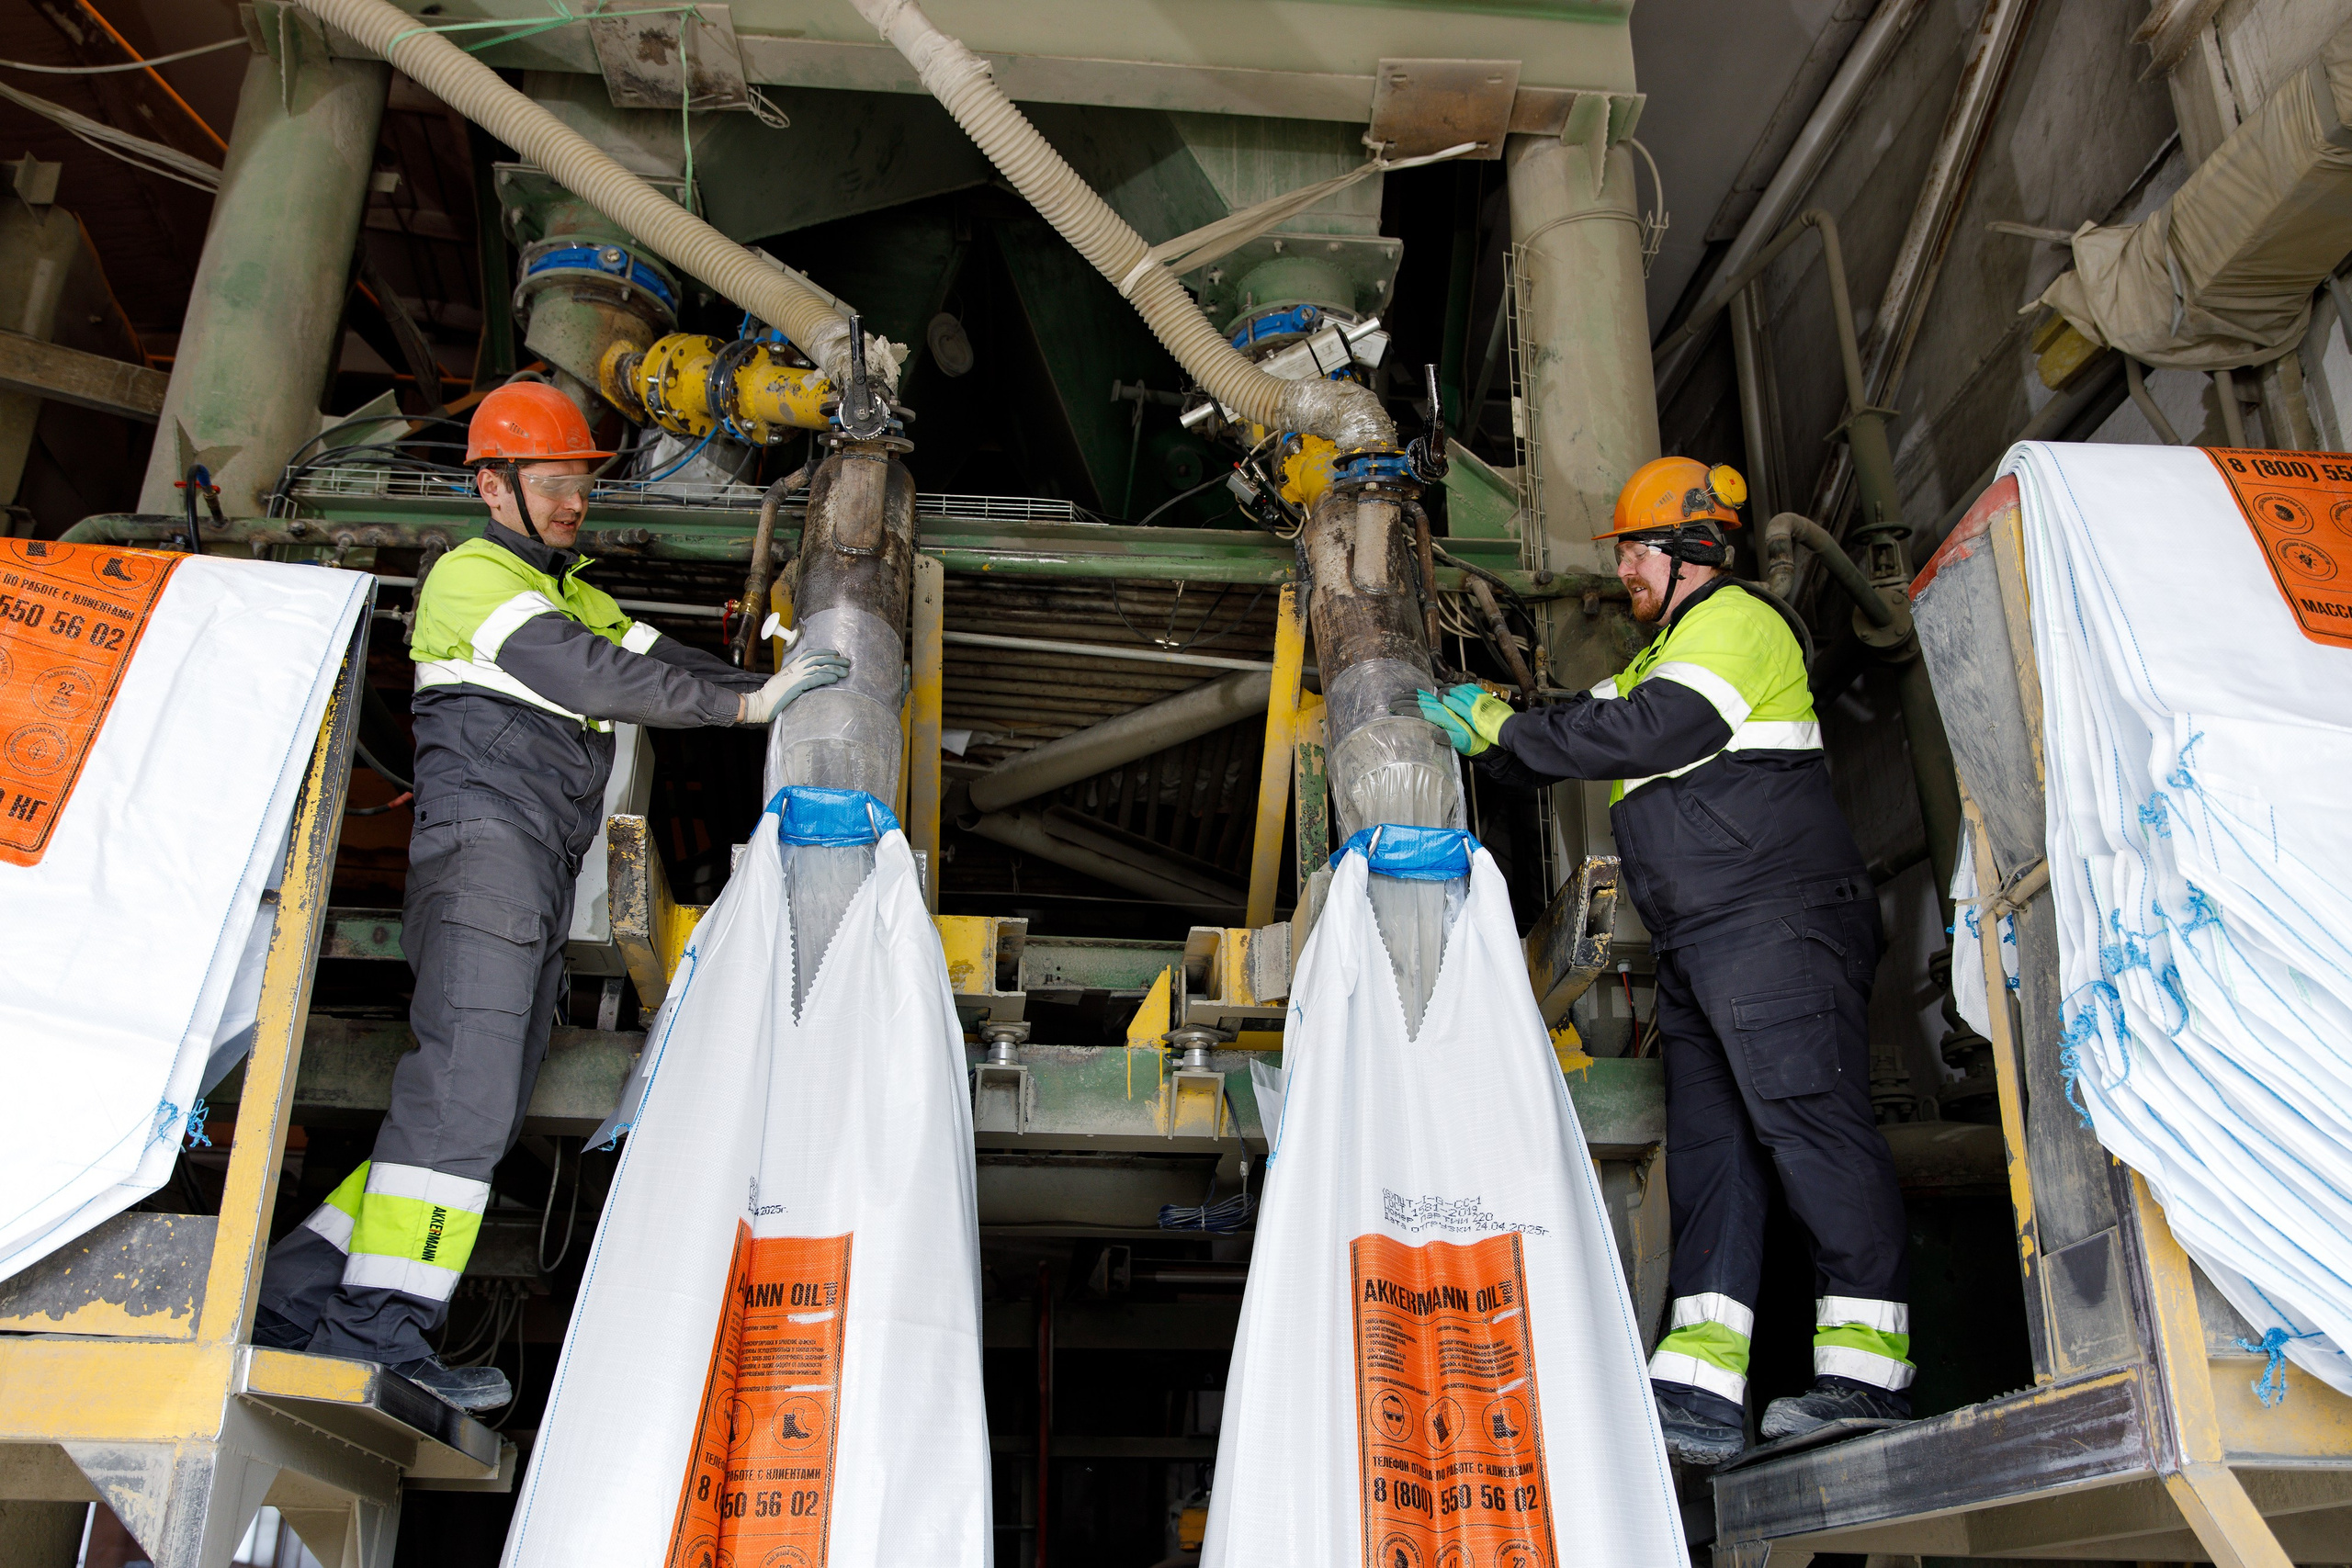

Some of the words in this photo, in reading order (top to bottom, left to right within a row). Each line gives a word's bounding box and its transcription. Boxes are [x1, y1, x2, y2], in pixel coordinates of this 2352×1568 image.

[2227, 457, 2247, 473] 8
[2251, 459, 2319, 482] (800)
[2320, 464, 2352, 482] 55
[4, 573, 19, 586] ПО
[20, 579, 61, 598] РАБОТЕ
[62, 591, 71, 601] С
[72, 593, 135, 621] КЛИЕНТАМИ
[0, 594, 45, 627] 550
[50, 610, 85, 639] 56
[89, 623, 125, 651] 02
[57, 682, 74, 697] 22
[8, 794, 48, 822] КГ
[1472, 1213, 1494, 1223] 220
[421, 1206, 447, 1262] AKKERMANN
[790, 1282, 822, 1307] OIL
[1363, 1279, 1469, 1316] AKKERMANN
[1476, 1284, 1501, 1313] OIL
[726, 1470, 753, 1483] РАБОТЕ
[758, 1470, 764, 1481] С
[766, 1469, 821, 1482] КЛИЕНТАМИ
[1373, 1456, 1408, 1472] ТЕЛЕФОН
[1411, 1462, 1433, 1481] ОТДЕЛА
[1436, 1469, 1445, 1482] ПО
[1446, 1462, 1475, 1479] РАБОТЕ
[1477, 1463, 1484, 1474] С
[1486, 1461, 1534, 1479] КЛИЕНТАМИ
[698, 1474, 711, 1502] 8
[1374, 1477, 1387, 1503] 8
[1394, 1480, 1433, 1519] (800)
[1441, 1483, 1471, 1515] 550
[1480, 1483, 1506, 1512] 56
[1514, 1484, 1538, 1512] 02
[723, 1492, 748, 1519] 50
[755, 1490, 782, 1518] 56
[790, 1490, 820, 1517] 02
